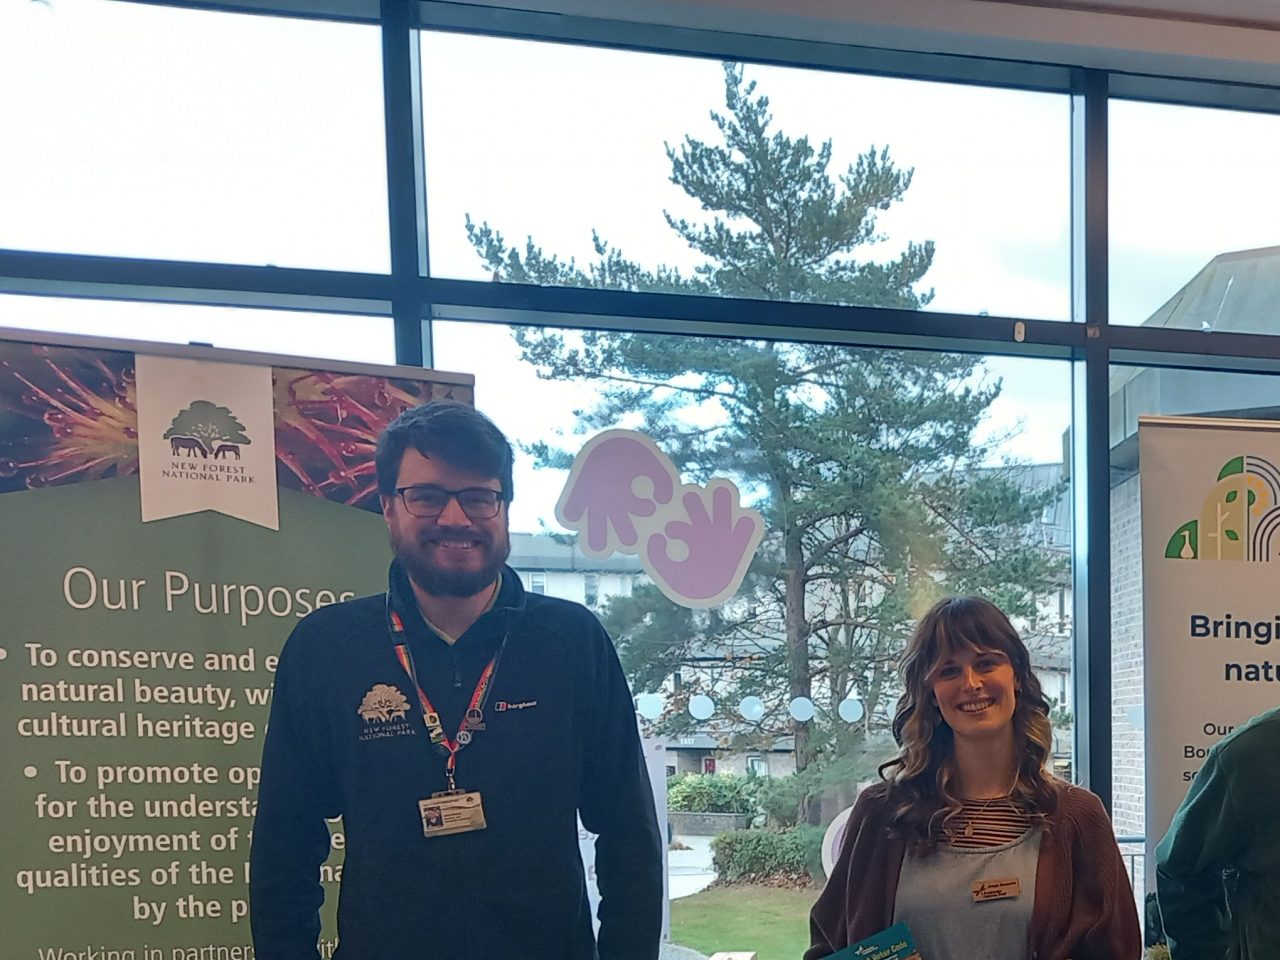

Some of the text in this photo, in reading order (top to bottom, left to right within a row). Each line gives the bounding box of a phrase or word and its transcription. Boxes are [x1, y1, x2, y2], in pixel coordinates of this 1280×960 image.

[162, 470, 256, 484] NATIONAL PARK
[171, 461, 246, 475] NEW FOREST
[63, 566, 146, 611] Our
[25, 643, 57, 667] To
[67, 647, 194, 670] conserve
[204, 648, 255, 672] and
[21, 679, 124, 702] natural
[135, 679, 238, 710] beauty,
[17, 712, 126, 738] cultural
[138, 714, 255, 744] heritage
[1203, 723, 1234, 736] Our
[55, 761, 86, 783] To
[98, 762, 218, 789] promote
[36, 794, 77, 818] for
[88, 795, 134, 818] the
[49, 828, 239, 858] enjoyment of
[17, 861, 233, 894] qualities of the
[134, 896, 167, 925] by
[176, 898, 221, 920] the
